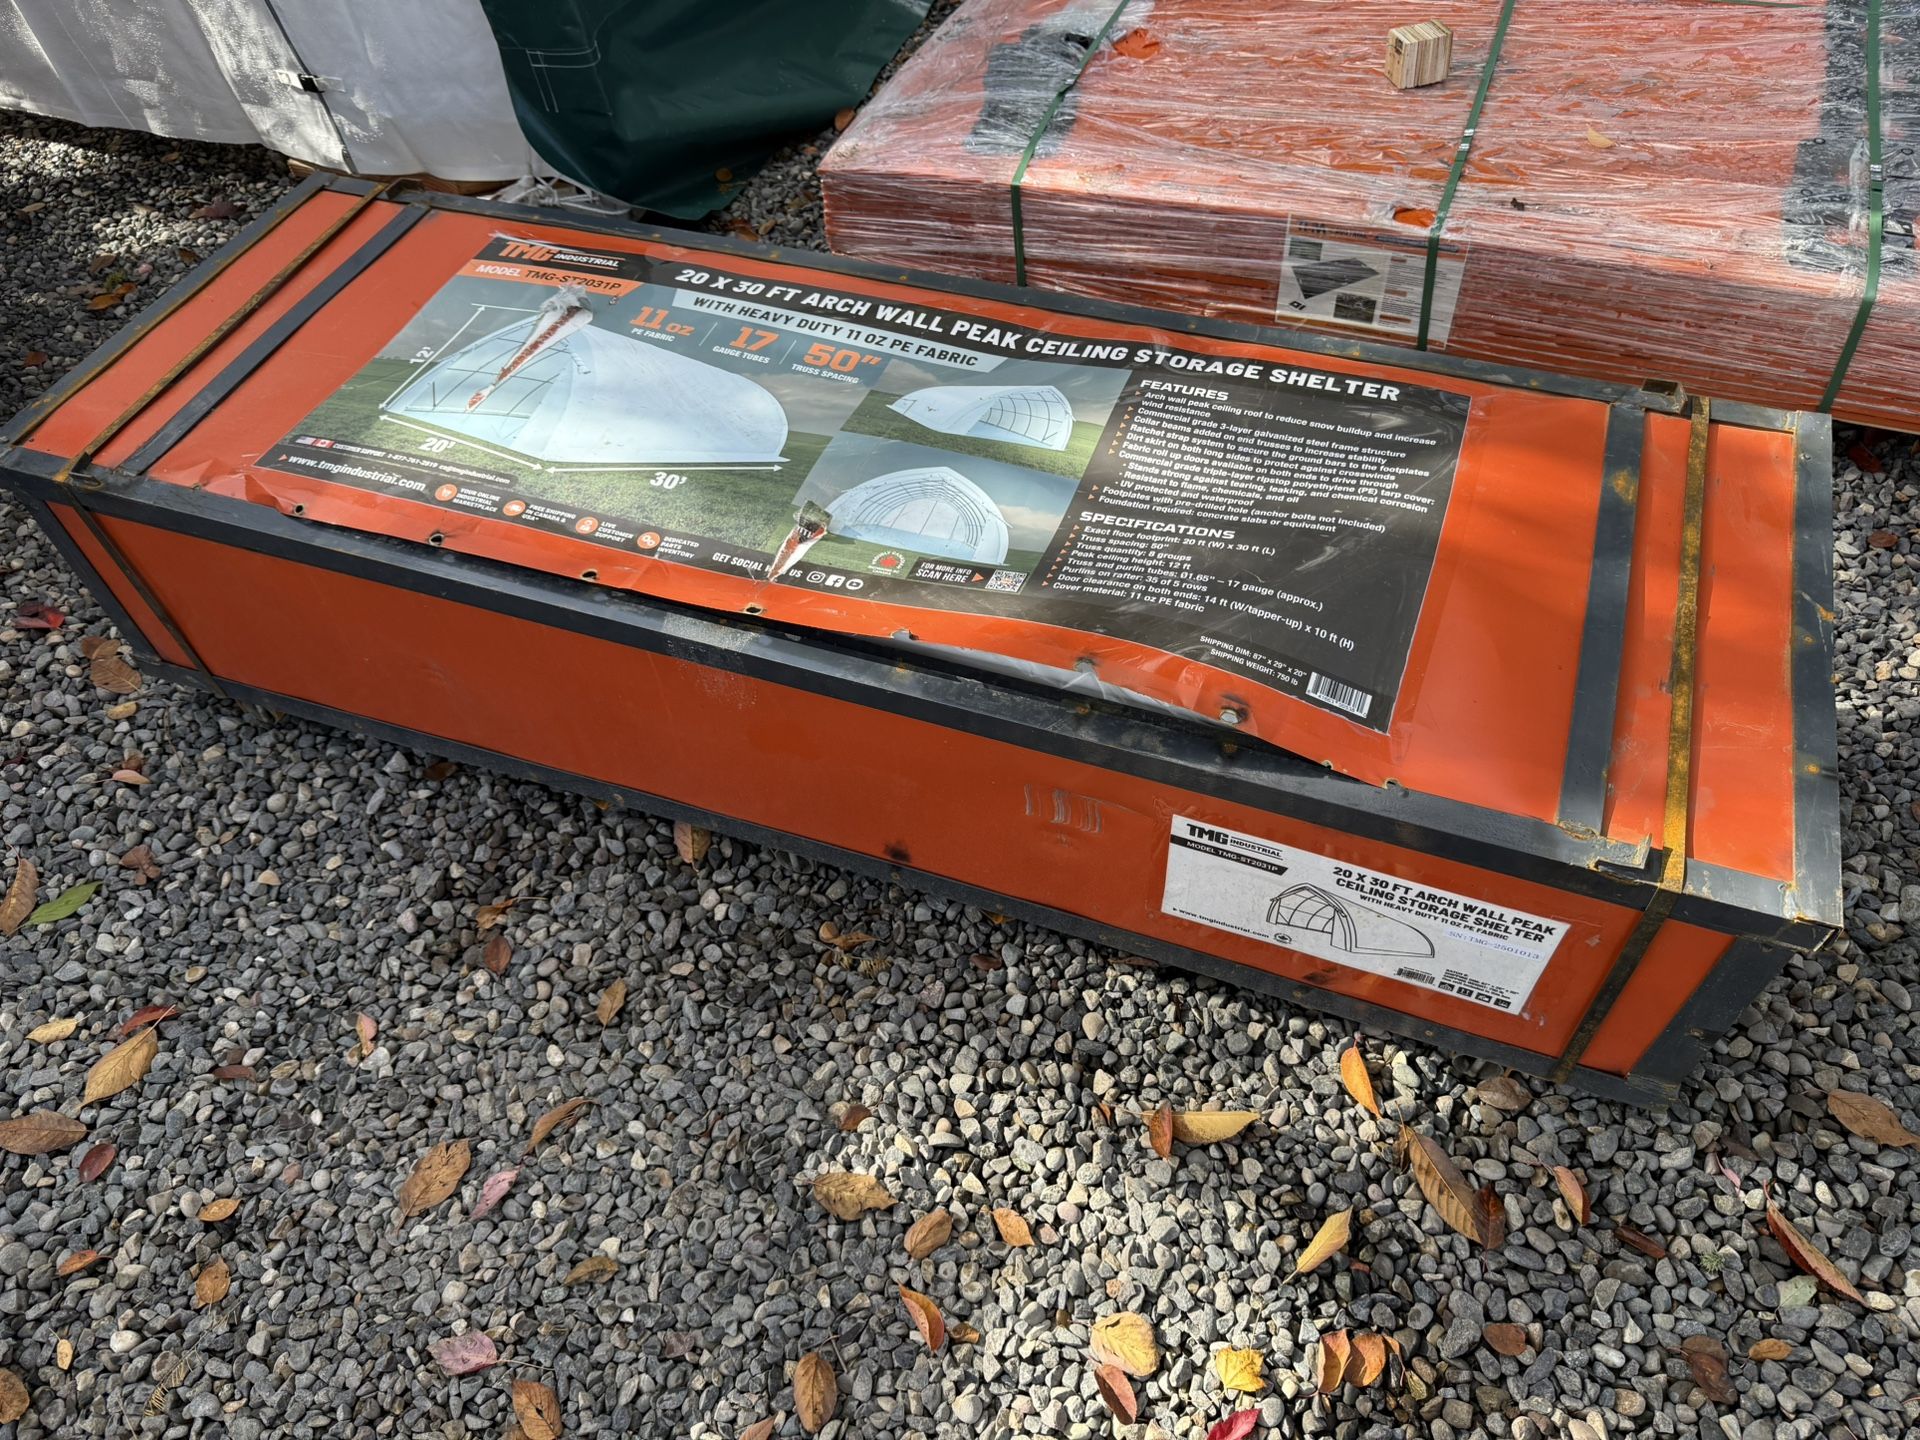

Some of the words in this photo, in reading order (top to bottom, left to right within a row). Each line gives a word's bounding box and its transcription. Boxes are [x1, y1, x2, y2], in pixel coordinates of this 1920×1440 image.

[499, 241, 560, 260] TMG
[554, 254, 619, 267] INDUSTRIAL
[476, 265, 521, 276] MODEL
[630, 307, 669, 329] 11
[666, 323, 695, 336] oz
[631, 327, 645, 335] PE
[643, 330, 675, 342] FABRIC
[675, 269, 710, 284] 20
[709, 276, 733, 290] X
[732, 281, 766, 295] 30
[765, 286, 802, 301] FT
[800, 292, 872, 316] ARCH
[875, 304, 943, 333] WALL
[950, 320, 1022, 350] PEAK
[1025, 337, 1129, 361] CEILING
[1134, 349, 1264, 380] STORAGE
[1269, 369, 1400, 401] SHELTER
[693, 296, 737, 313] WITH
[737, 306, 795, 325] HEAVY
[796, 318, 844, 336] DUTY
[846, 329, 862, 341] 11
[864, 333, 888, 347] OZ
[889, 339, 914, 353] PE
[914, 344, 978, 366] FABRIC
[730, 327, 780, 350] 17
[712, 345, 742, 357] GAUGE
[742, 352, 770, 364] TUBES
[803, 343, 881, 374] 50"
[791, 363, 821, 375] TRUSS
[820, 370, 859, 385] SPACING
[1140, 379, 1229, 401] FEATURES
[1141, 400, 1164, 409] wind
[1164, 404, 1211, 418] resistance
[1144, 391, 1166, 401] Arch
[1167, 396, 1187, 404] wall
[1187, 400, 1210, 409] peak
[1211, 404, 1242, 416] ceiling
[1243, 409, 1264, 418] roof
[1264, 412, 1274, 420] to
[1275, 415, 1308, 426] reduce
[1309, 421, 1335, 431] snow
[1336, 425, 1373, 438] buildup
[1374, 432, 1393, 440] and
[1394, 434, 1437, 446] increase
[1137, 407, 1191, 423] Commercial
[1191, 418, 1218, 429] grade
[1219, 423, 1253, 435] 3-layer
[1253, 430, 1305, 444] galvanized
[1305, 439, 1330, 448] steel
[1331, 442, 1360, 452] frame
[1361, 447, 1406, 458] structure
[288, 455, 426, 491] www.tmgindustrial.com
[1118, 450, 1174, 468] Commercial
[1173, 462, 1201, 473] grade
[1202, 466, 1255, 481] triple-layer
[1256, 475, 1291, 487] ripstop
[1292, 481, 1356, 493] polyethylene
[1380, 489, 1402, 499] tarp
[1098, 495, 1151, 510] Foundation
[1196, 511, 1239, 521] concrete
[1241, 516, 1268, 524] slabs
[1283, 521, 1337, 532] equivalent
[1102, 486, 1151, 501] Footplates
[1153, 496, 1174, 504] with
[1174, 499, 1226, 511] pre-drilled
[1227, 505, 1249, 514] hole
[1291, 512, 1316, 521] bolts
[1338, 517, 1386, 534] included)
[1079, 511, 1236, 539] SPECIFICATIONS
[1081, 533, 1107, 543] Truss
[1083, 525, 1111, 535] Exact
[1112, 529, 1135, 538] floor
[1251, 545, 1260, 553] ft
[712, 552, 731, 563] GET
[730, 556, 763, 572] SOCIAL
[790, 570, 803, 578] US
[915, 568, 942, 580] SCAN
[942, 573, 969, 583] HERE
[920, 562, 935, 570] FOR
[934, 564, 955, 573] MORE
[955, 567, 972, 575] INFO
[1057, 573, 1081, 582] Door
[1082, 577, 1131, 588] clearance
[1132, 583, 1146, 591] on
[1147, 585, 1171, 595] both
[1205, 595, 1217, 604] 14
[1219, 598, 1228, 607] ft
[1304, 624, 1312, 633] x
[1315, 627, 1327, 639] 10
[1329, 632, 1338, 643] ft
[1199, 635, 1234, 651] SHIPPING
[1210, 648, 1245, 665] SHIPPING
[1277, 672, 1290, 682] 750
[1290, 677, 1298, 686] lb
[1187, 824, 1229, 845] TMG
[1230, 838, 1282, 858] INDUSTRIAL
[1187, 841, 1215, 853] MODEL
[1218, 850, 1278, 871] TMG-ST2031P
[1332, 866, 1353, 879] 20
[1355, 872, 1367, 883] X
[1369, 877, 1389, 889] 30
[1391, 883, 1413, 895] FT
[1414, 890, 1459, 909] ARCH
[1463, 903, 1507, 923] WALL
[1511, 917, 1556, 936] PEAK
[1336, 878, 1395, 901] CEILING
[1397, 895, 1471, 923] STORAGE
[1473, 917, 1545, 943] SHELTER
[1179, 909, 1269, 938] www.tmgindustrial.com
[1359, 894, 1383, 905] WITH
[1383, 901, 1413, 914] HEAVY
[1414, 910, 1439, 921] DUTY
[1449, 920, 1462, 928] OZ
[1463, 924, 1475, 932] PE
[1476, 927, 1509, 941] FABRIC
